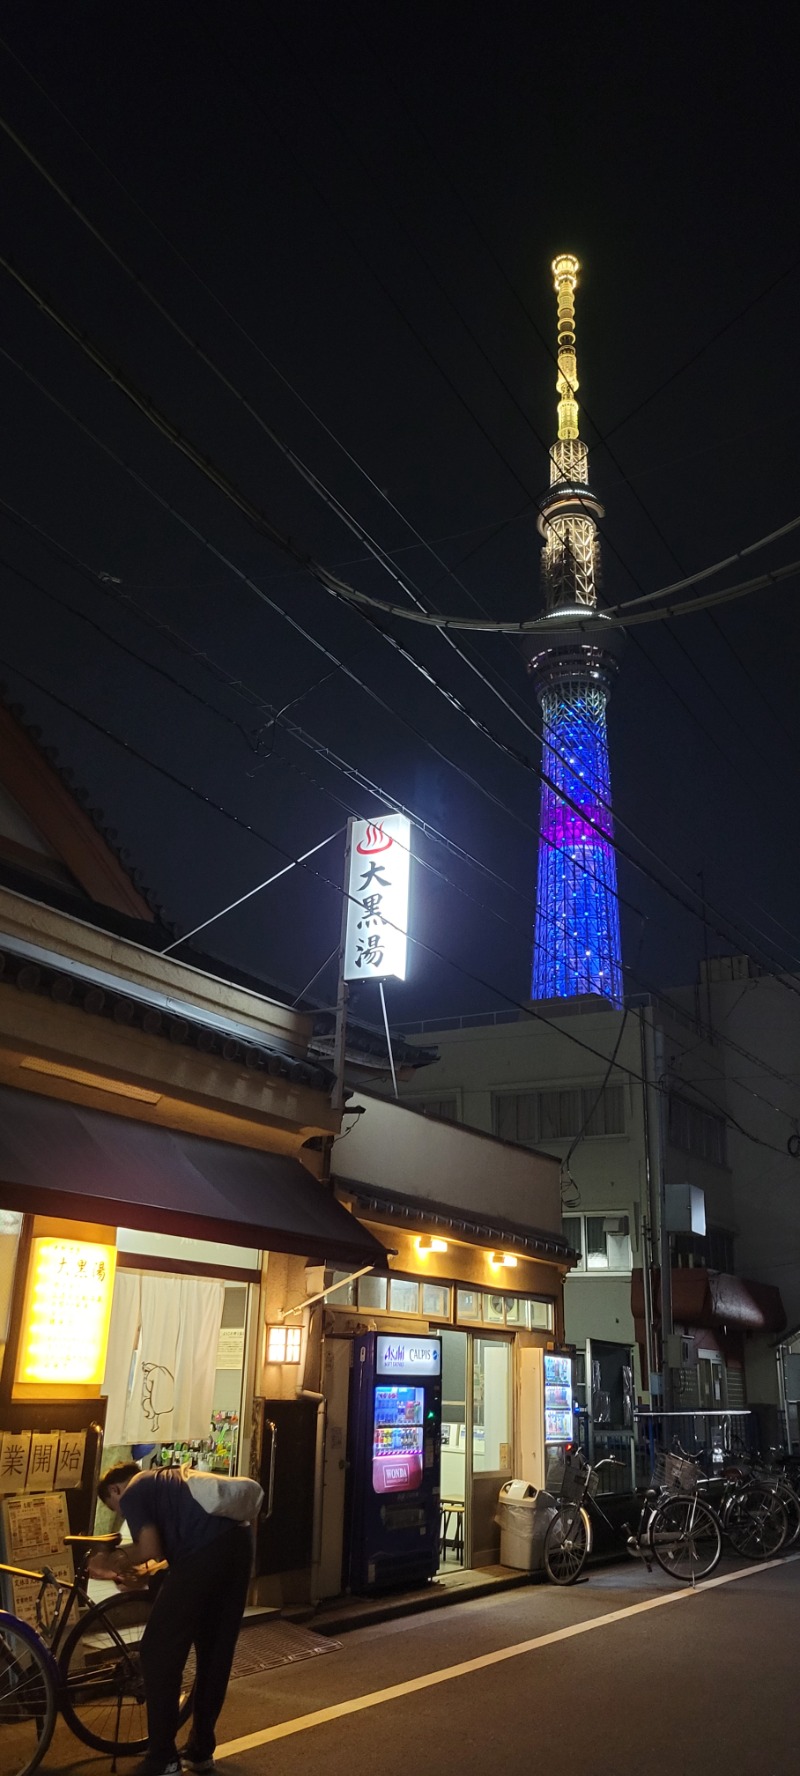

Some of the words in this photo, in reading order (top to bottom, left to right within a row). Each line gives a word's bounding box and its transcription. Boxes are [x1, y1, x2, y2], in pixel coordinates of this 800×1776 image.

[355, 860, 391, 968] 大黒湯
[57, 1256, 106, 1282] 大黒湯
[384, 1344, 405, 1361] Asahi
[409, 1348, 431, 1362] CALPIS
[1, 1442, 81, 1475] 業開始
[385, 1468, 407, 1479] WONDA
